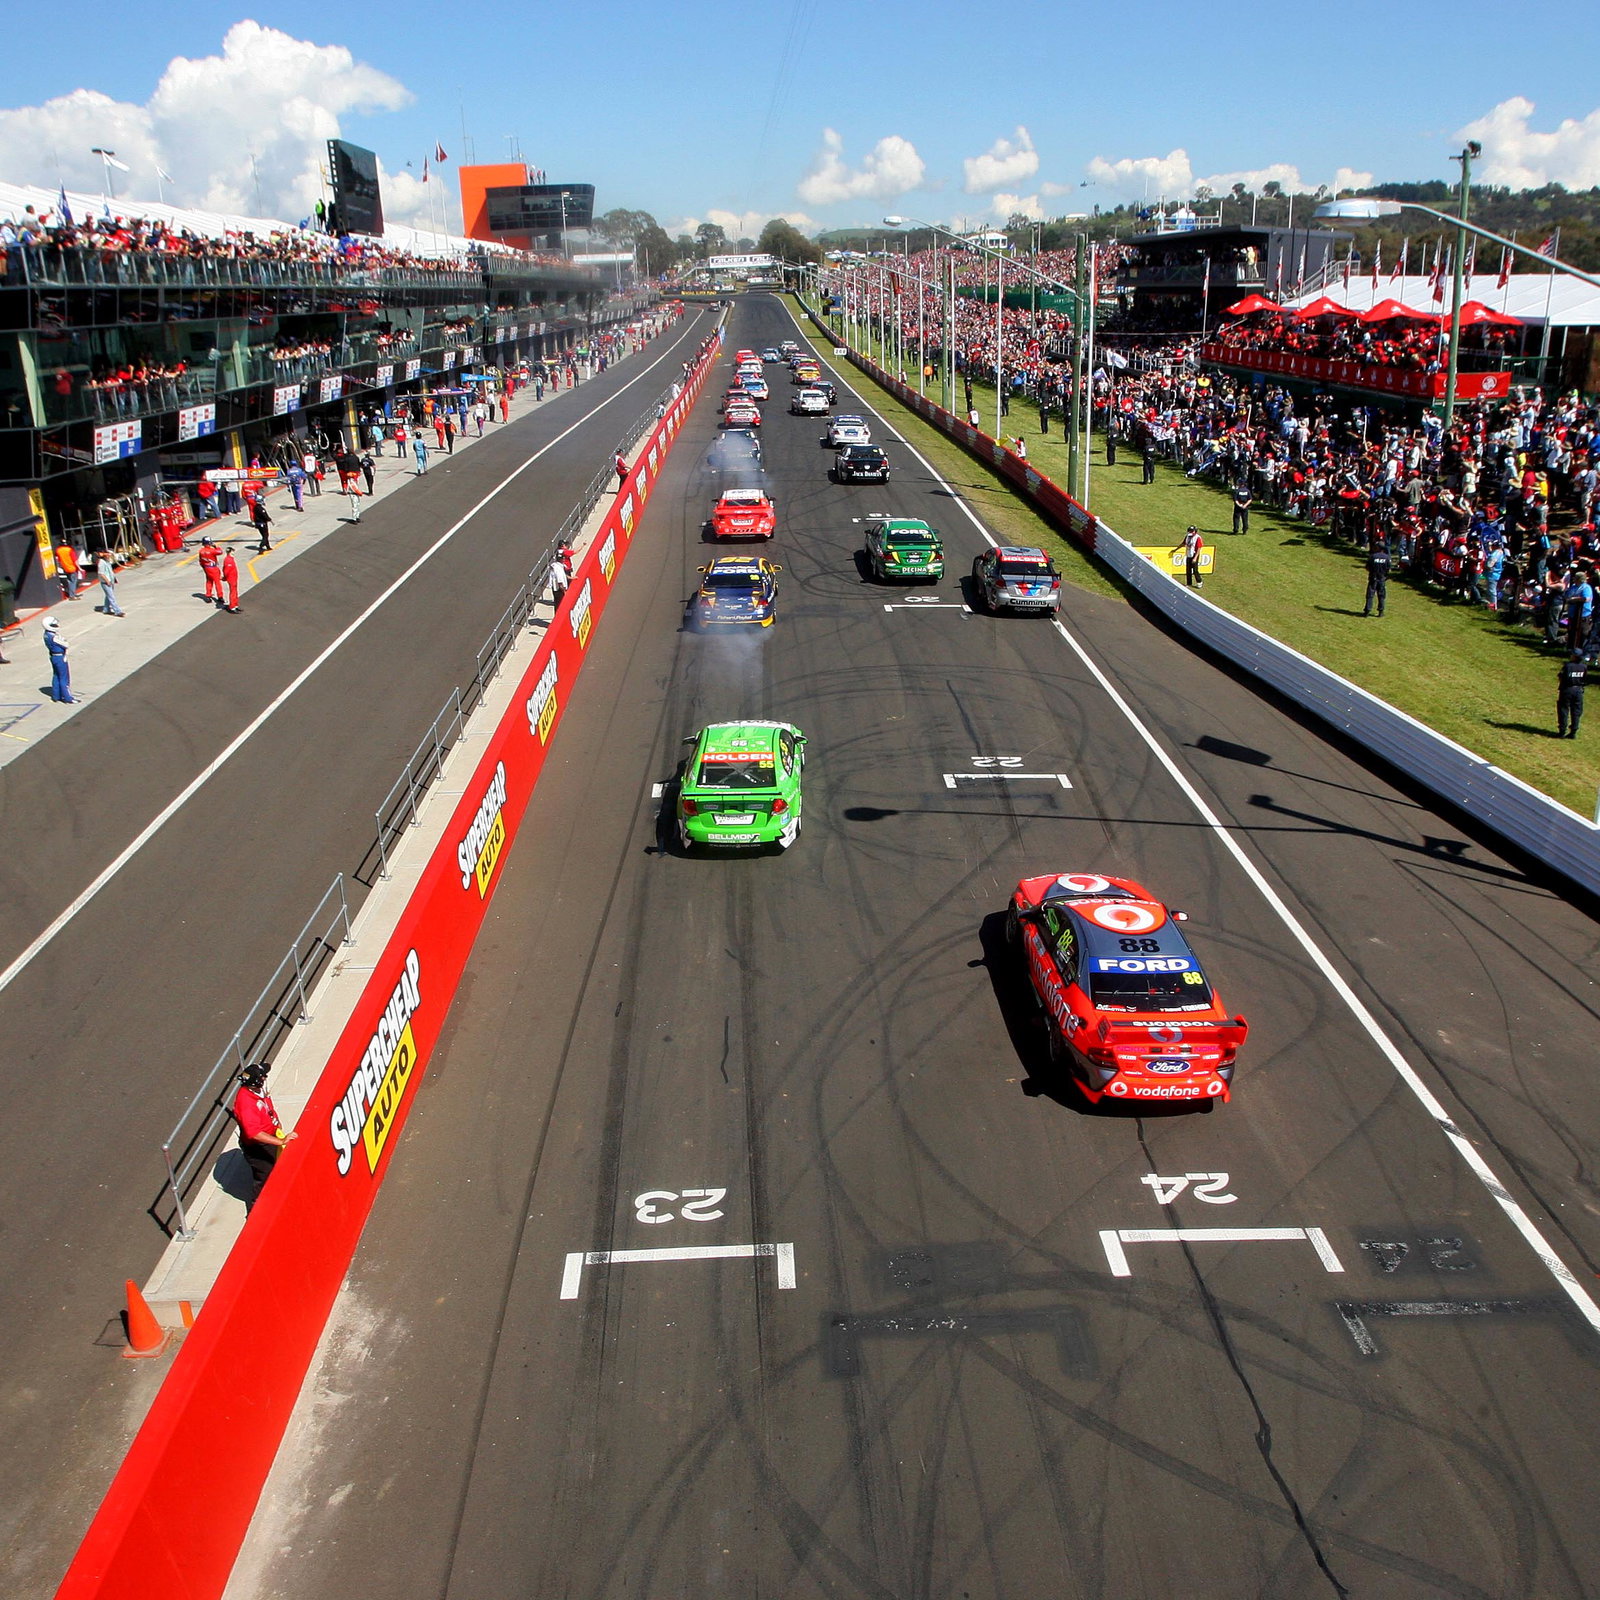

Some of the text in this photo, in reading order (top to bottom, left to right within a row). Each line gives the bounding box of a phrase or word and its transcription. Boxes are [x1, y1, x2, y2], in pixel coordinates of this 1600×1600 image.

[1173, 554, 1211, 566] GD
[1010, 598, 1047, 606] Cummins
[541, 697, 555, 732] AUTO
[703, 753, 773, 761] HOLDEN
[970, 756, 1025, 768] 22
[759, 760, 774, 769] 55
[457, 761, 507, 890] SUPERCHEAP
[481, 822, 502, 884] AUTO
[1058, 929, 1073, 947] 88
[1118, 938, 1161, 953] 88
[1097, 958, 1190, 972] FORD
[1182, 971, 1204, 985] 88
[330, 948, 421, 1175] SUPERCHEAP
[1152, 1061, 1185, 1072] Ford
[373, 1042, 410, 1147] AUTO
[1133, 1085, 1200, 1097] vodafone
[1141, 1172, 1239, 1206] 24
[635, 1187, 727, 1224] 23
